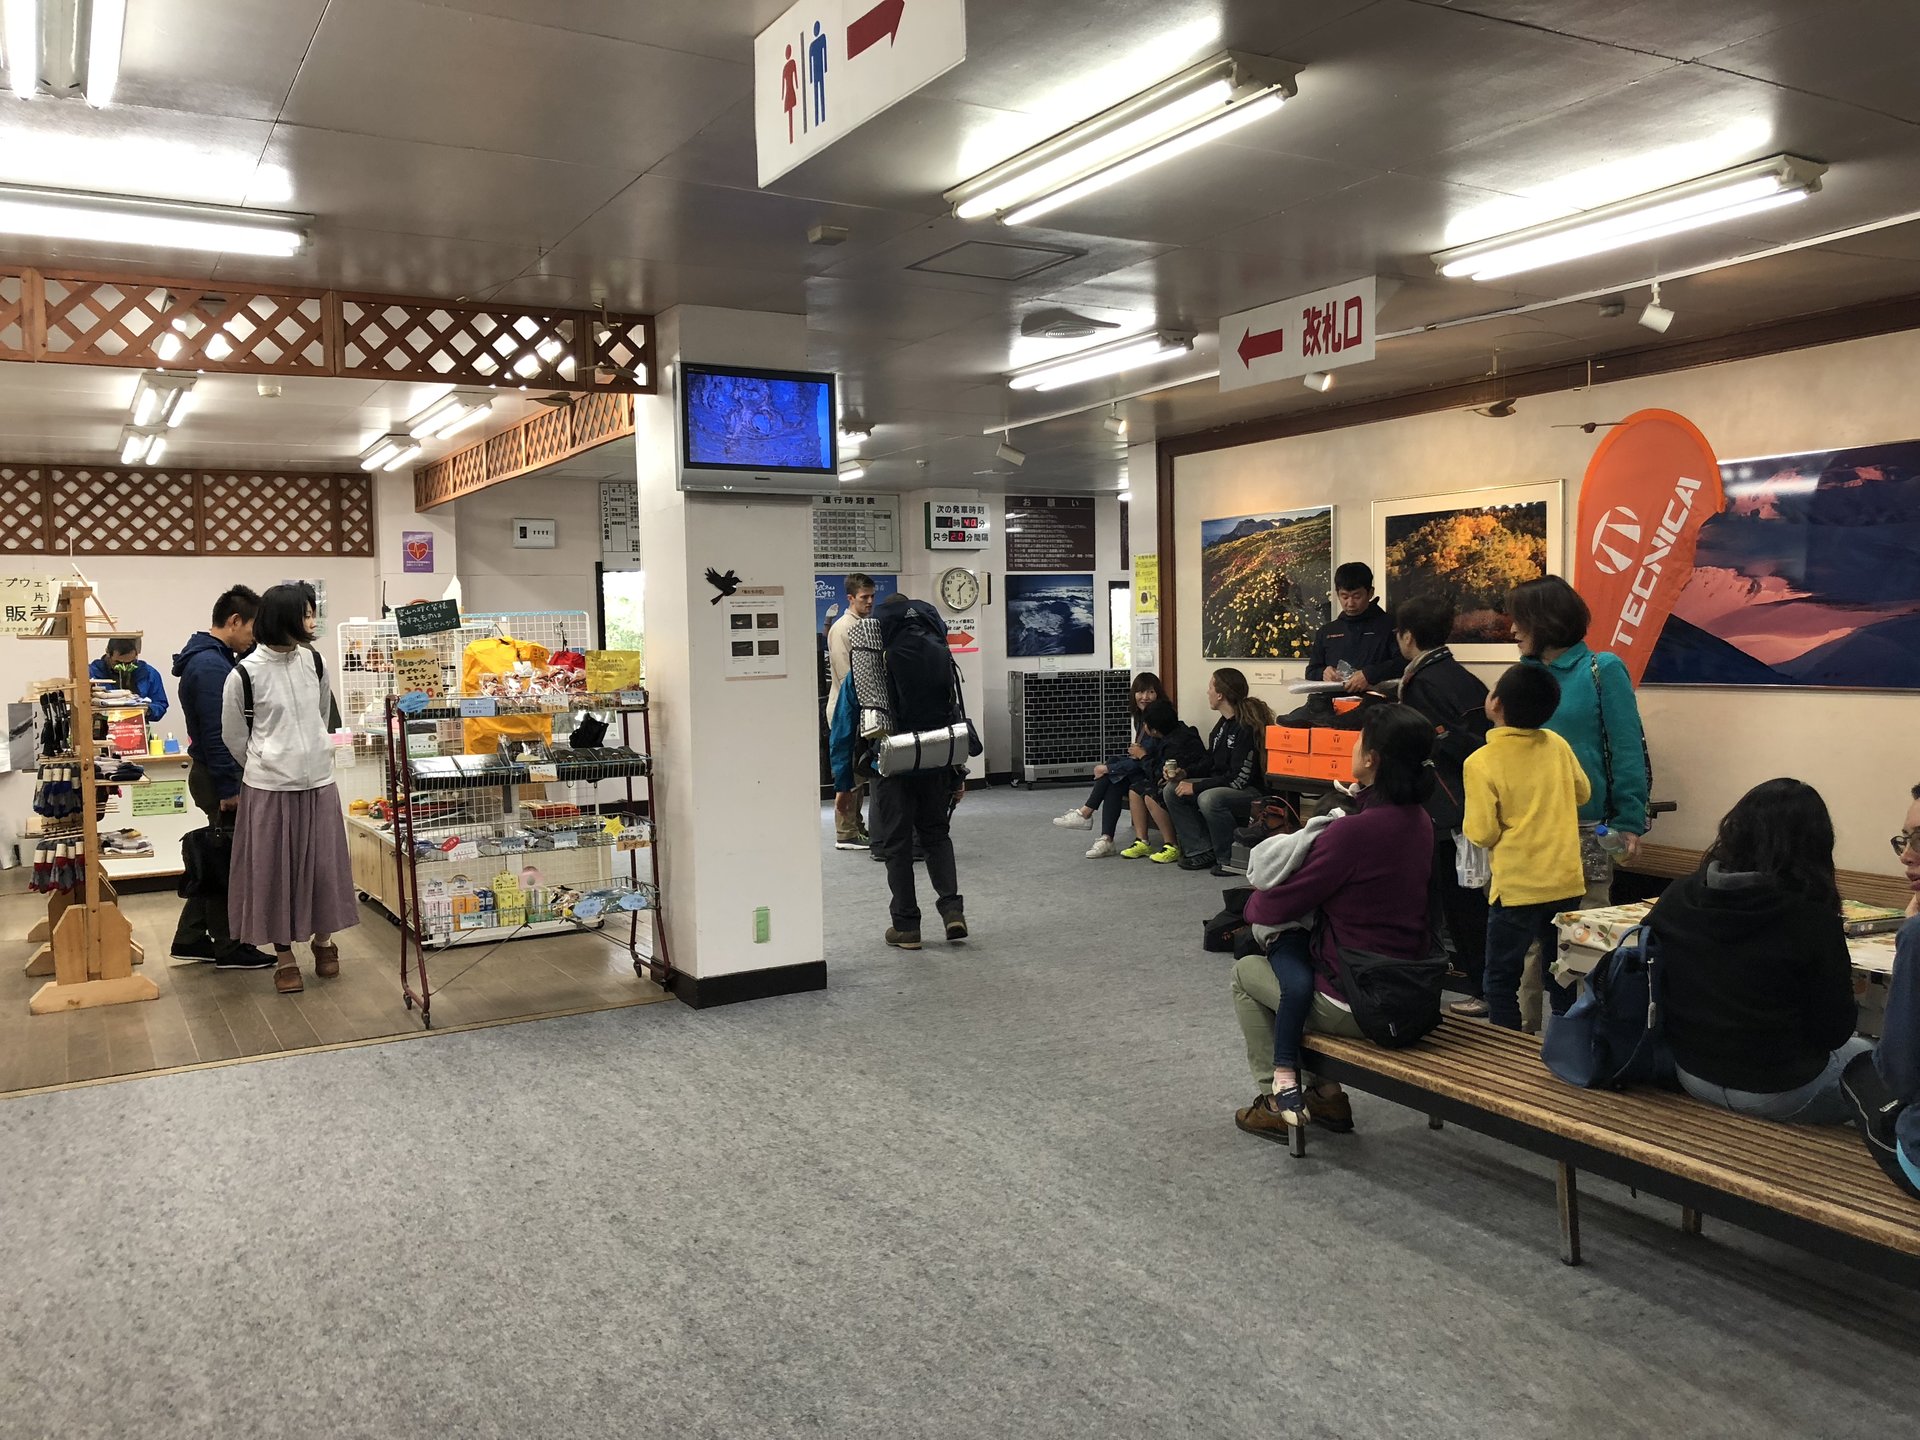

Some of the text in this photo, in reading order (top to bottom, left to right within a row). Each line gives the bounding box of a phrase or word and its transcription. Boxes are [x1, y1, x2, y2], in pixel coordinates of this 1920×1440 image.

[1303, 295, 1362, 357] 改札口
[936, 504, 985, 514] 次の発車時刻
[1610, 476, 1702, 646] TECNICA
[0, 577, 56, 588] プウェ
[33, 592, 50, 602] 片
